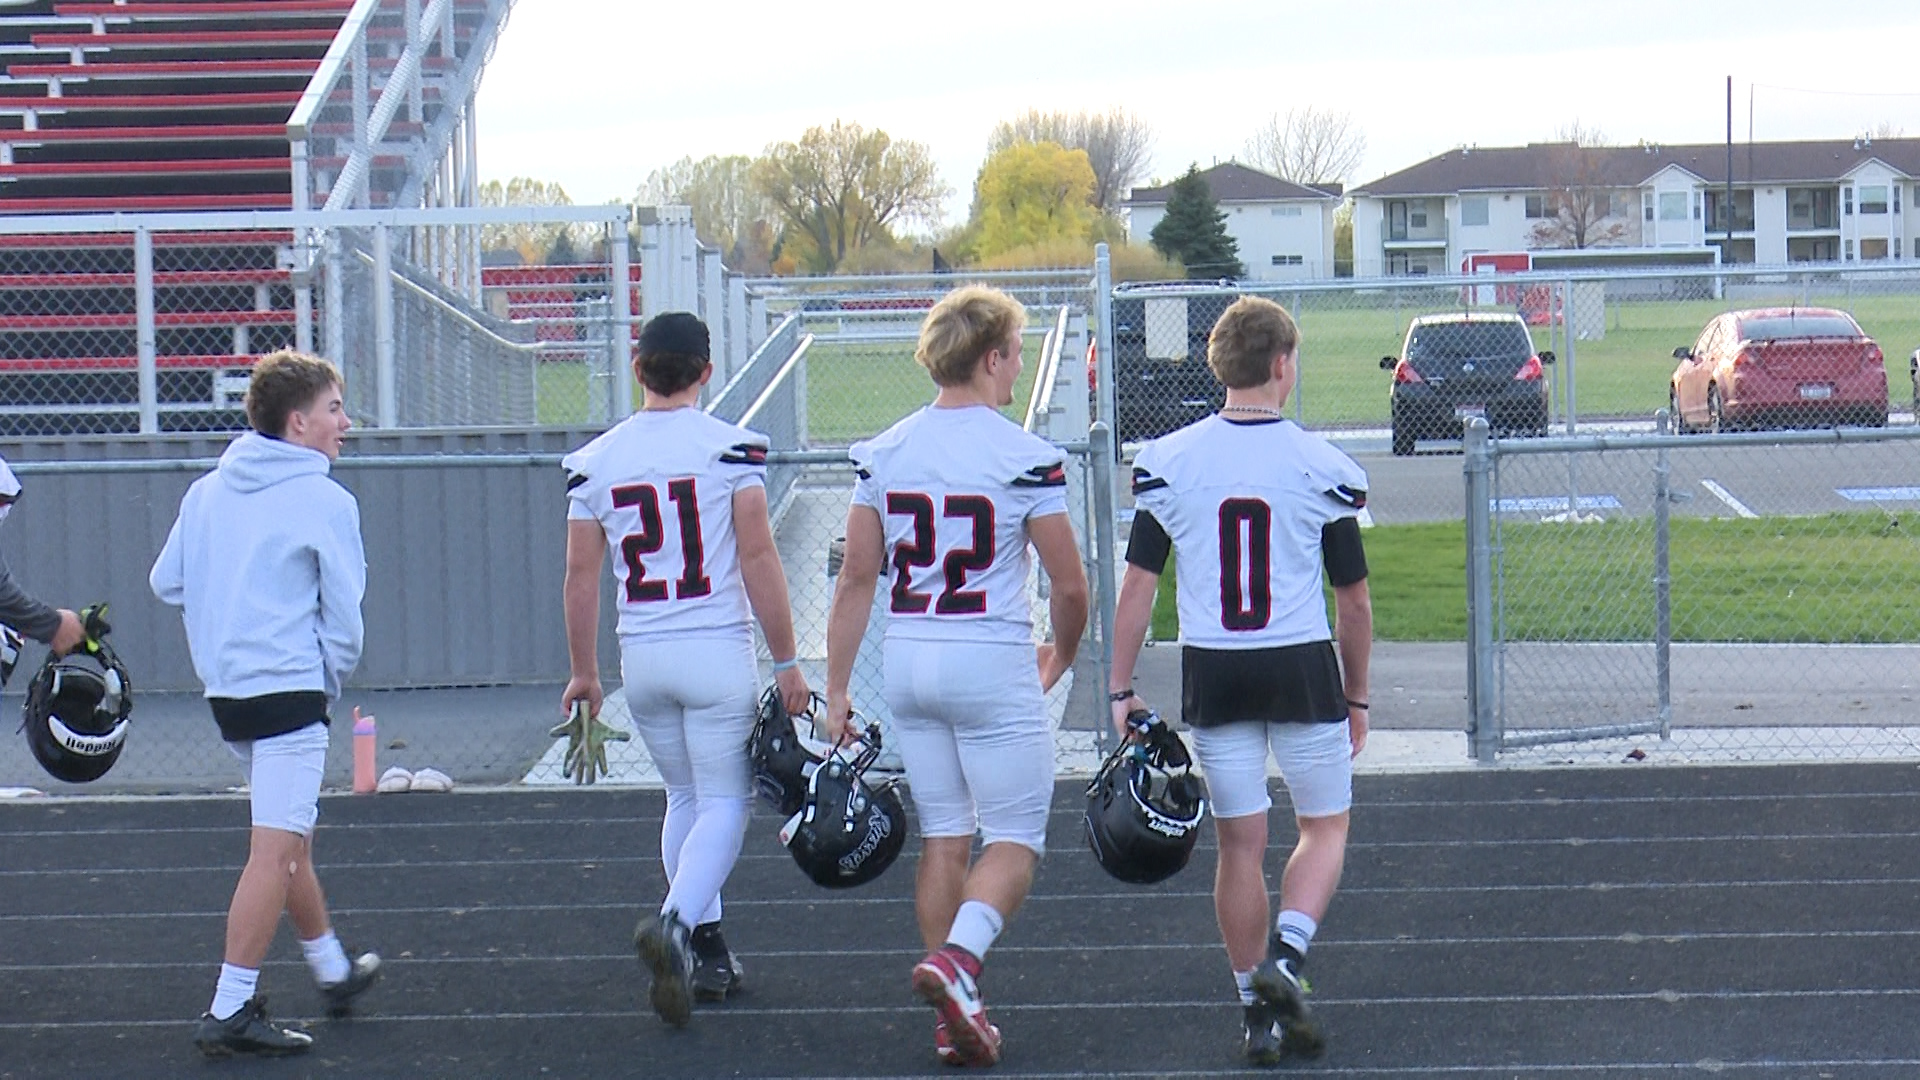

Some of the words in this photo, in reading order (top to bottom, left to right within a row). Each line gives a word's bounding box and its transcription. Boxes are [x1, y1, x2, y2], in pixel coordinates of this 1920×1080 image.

[611, 477, 711, 603] 21
[886, 491, 995, 614] 22
[1218, 497, 1271, 631] 0
